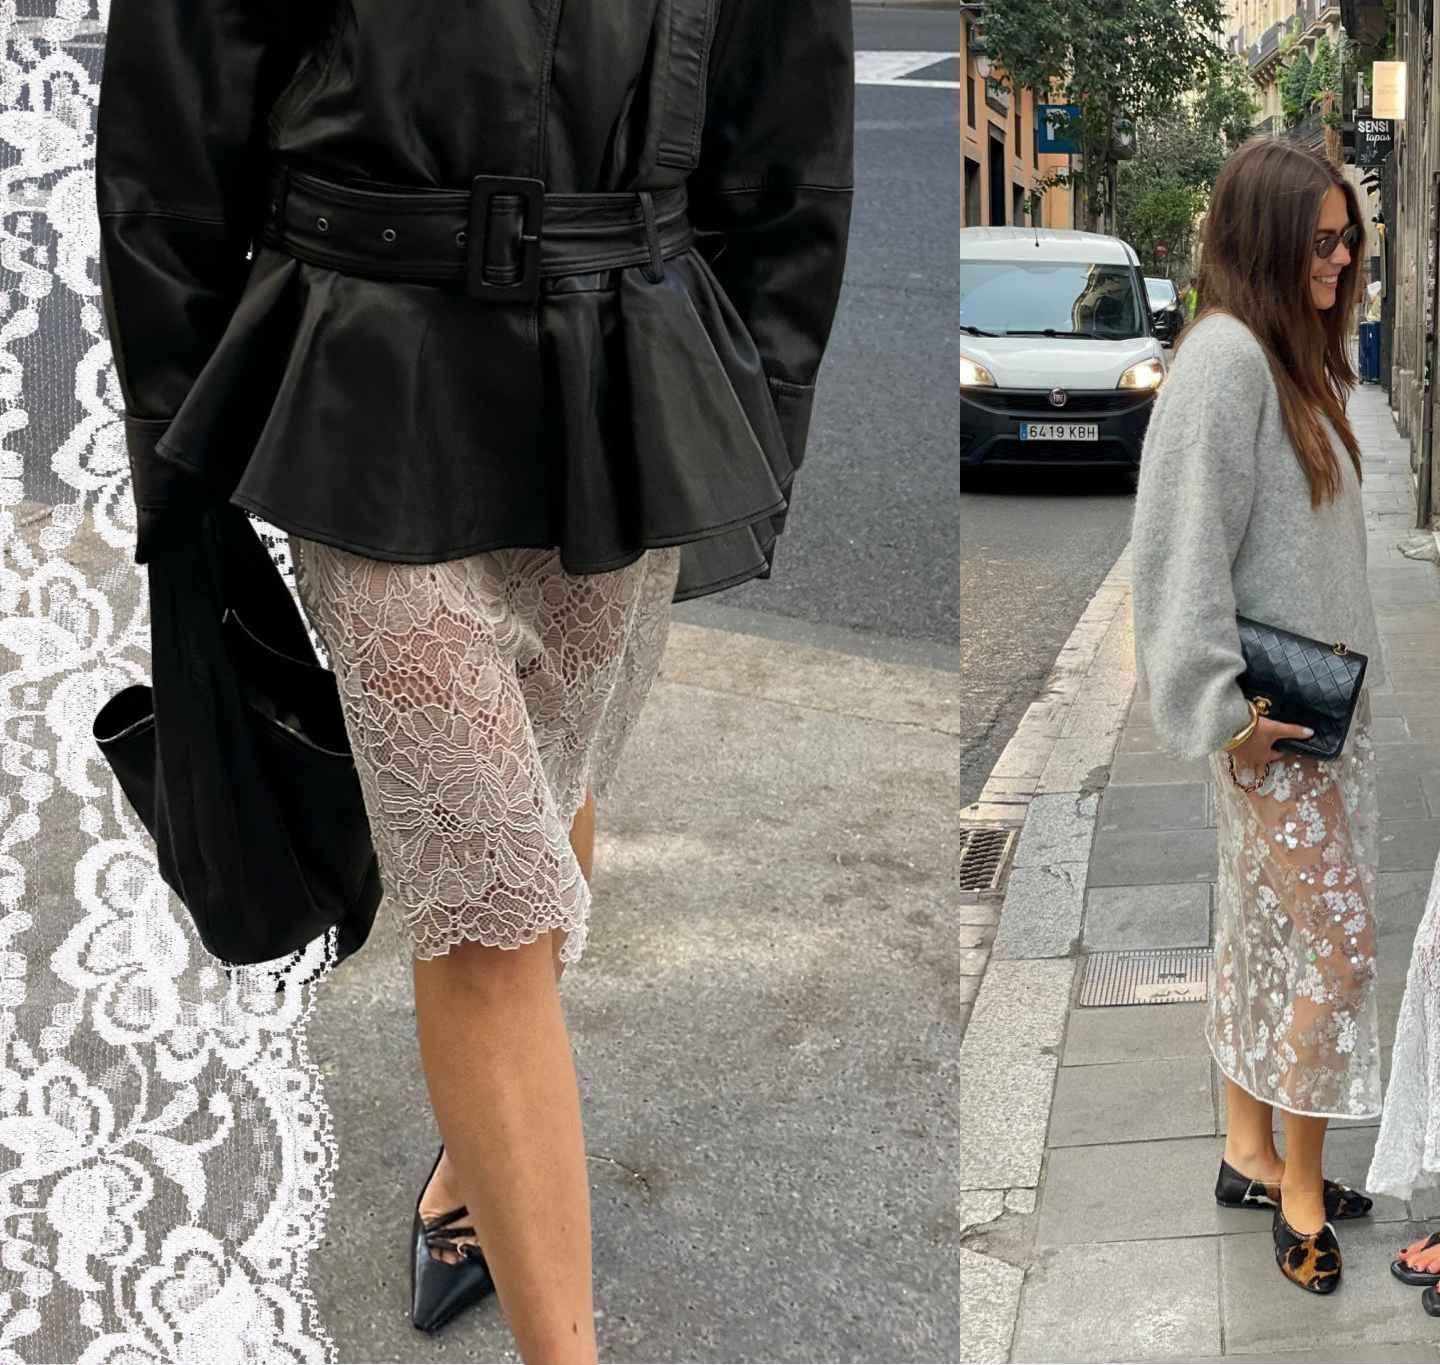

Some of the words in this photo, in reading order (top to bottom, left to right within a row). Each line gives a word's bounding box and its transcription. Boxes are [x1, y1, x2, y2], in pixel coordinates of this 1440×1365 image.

[1358, 120, 1389, 133] SENSI
[1366, 133, 1391, 147] tapas
[1029, 425, 1065, 438] 6419
[1069, 426, 1095, 438] KBH
